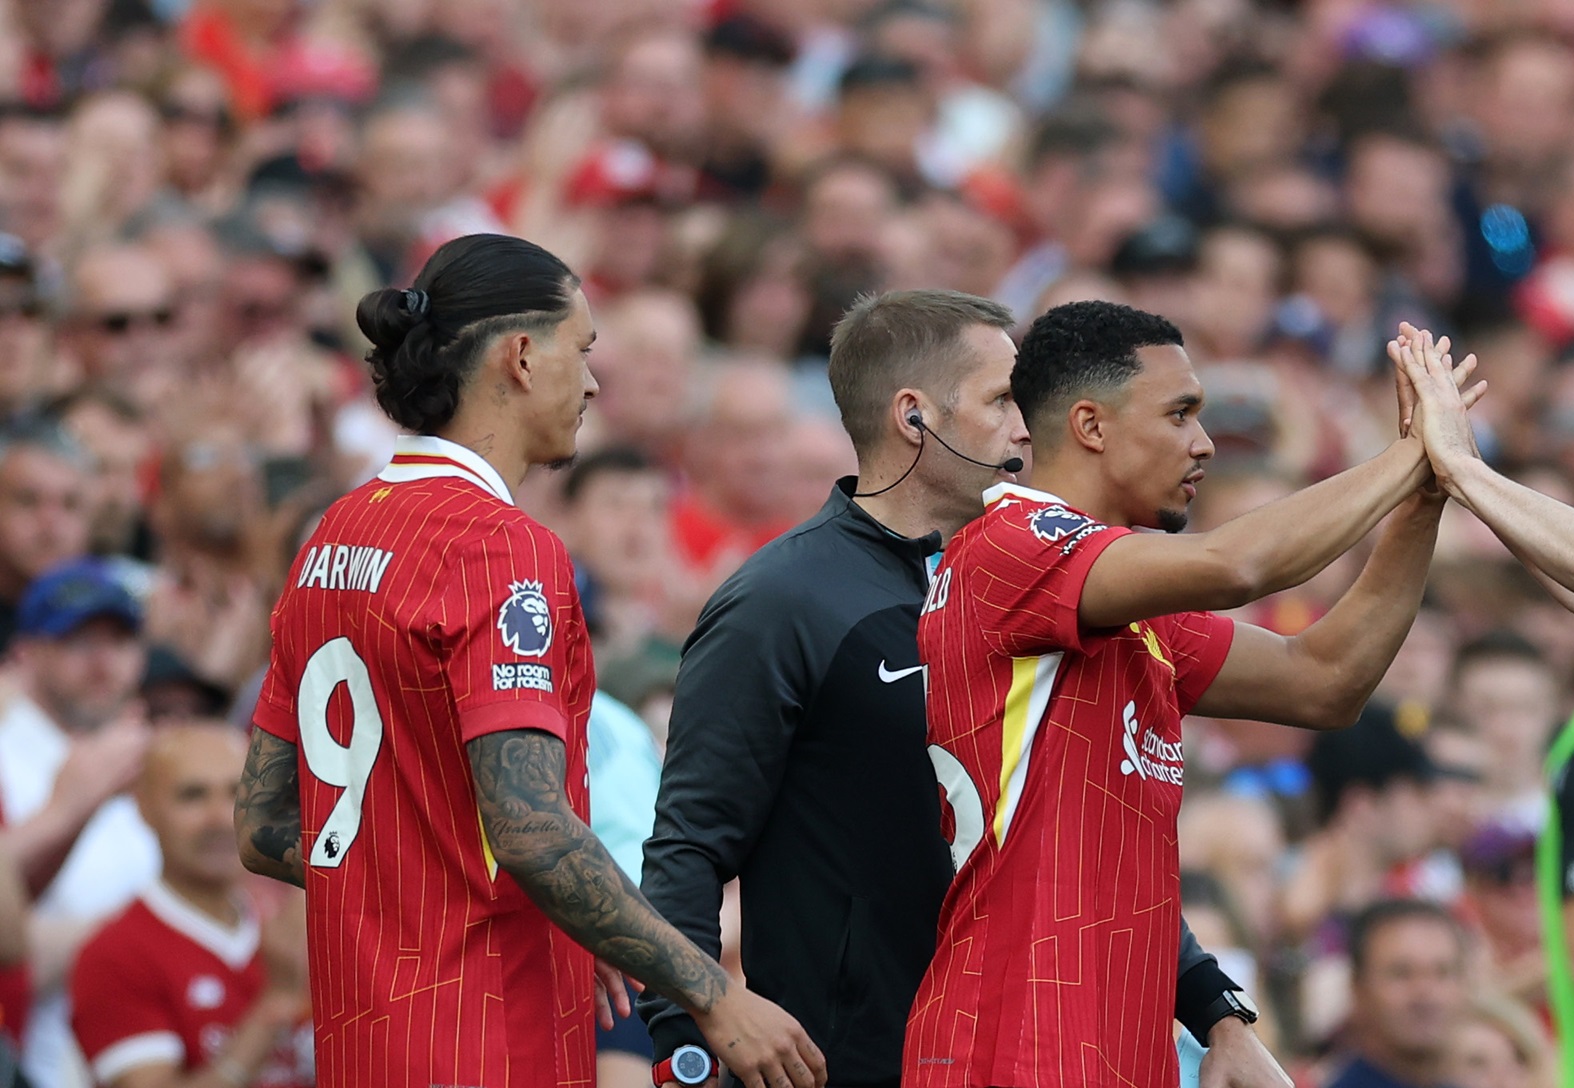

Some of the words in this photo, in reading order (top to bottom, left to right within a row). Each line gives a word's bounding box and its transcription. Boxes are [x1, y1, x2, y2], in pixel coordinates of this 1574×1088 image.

[297, 543, 395, 595] DARWIN
[492, 663, 516, 679] No
[516, 663, 550, 680] room
[516, 676, 554, 694] racism
[298, 634, 384, 868] 9
